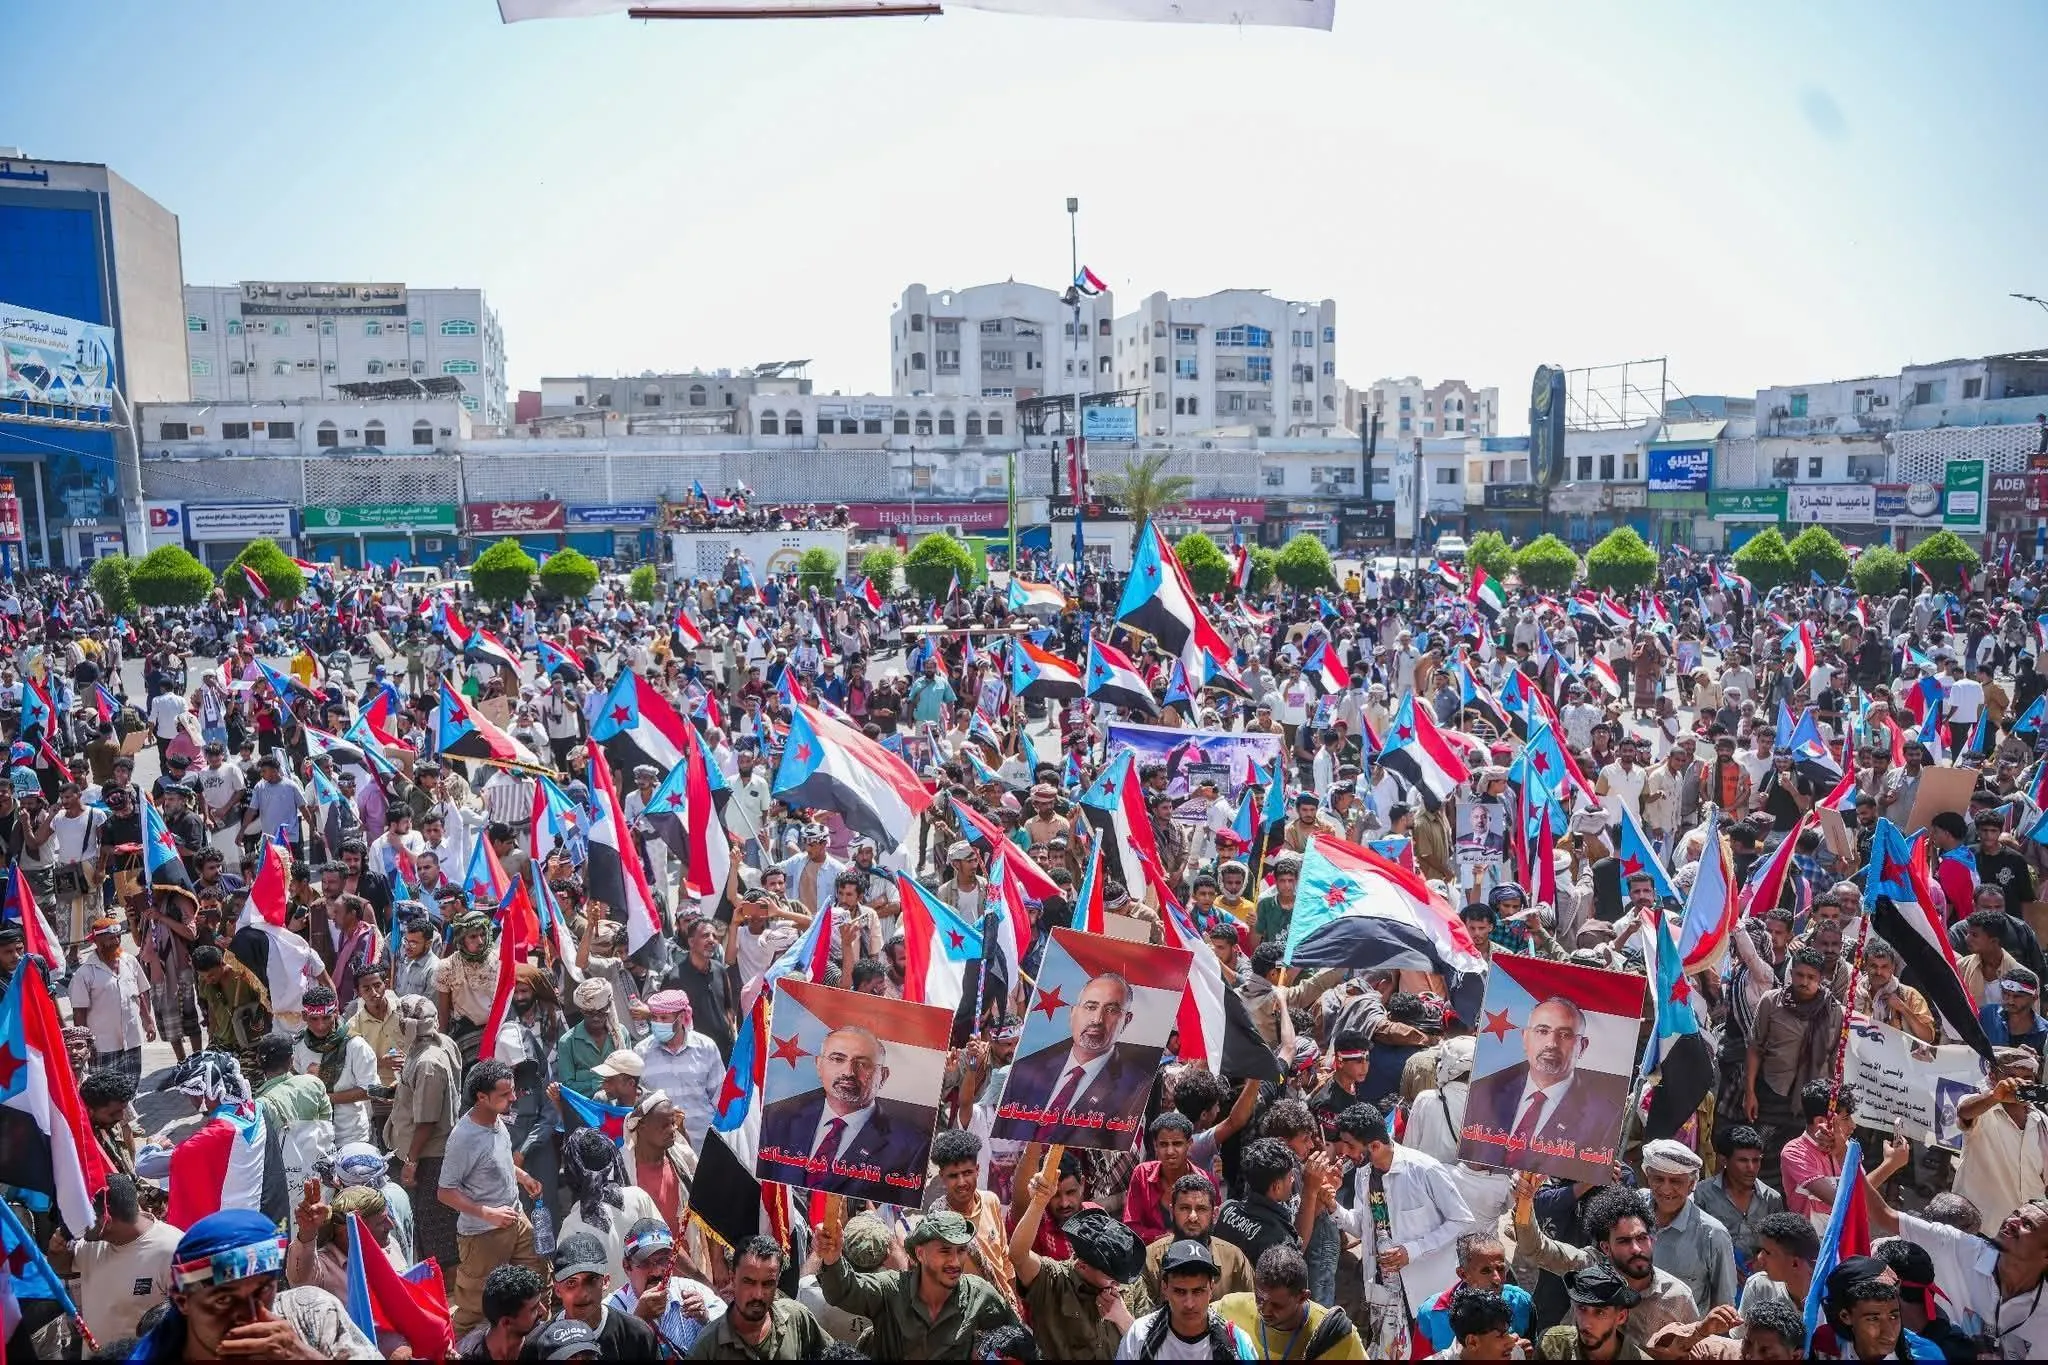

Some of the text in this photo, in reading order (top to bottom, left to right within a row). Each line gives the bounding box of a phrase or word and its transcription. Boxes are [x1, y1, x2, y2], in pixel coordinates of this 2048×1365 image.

[360, 287, 400, 302] فندق
[1667, 451, 1709, 469] الحريري
[1799, 494, 1871, 511] باعبيد للتجارة
[73, 518, 98, 527] ATM
[879, 511, 993, 525] High park market
[1883, 1069, 1904, 1079] ولي
[1858, 1070, 1909, 1093] الرئيس القائد
[1865, 1099, 1888, 1111] للقوات
[1884, 1094, 1893, 1102] بن
[1895, 1099, 1927, 1113] عيدروس
[997, 1101, 1138, 1134] انت قائدنا فوضناك
[1912, 1115, 1932, 1128] القائد
[1461, 1122, 1614, 1165] انت قائدنا فوضناك
[758, 1144, 922, 1191] انت قائدنا فوضناك
